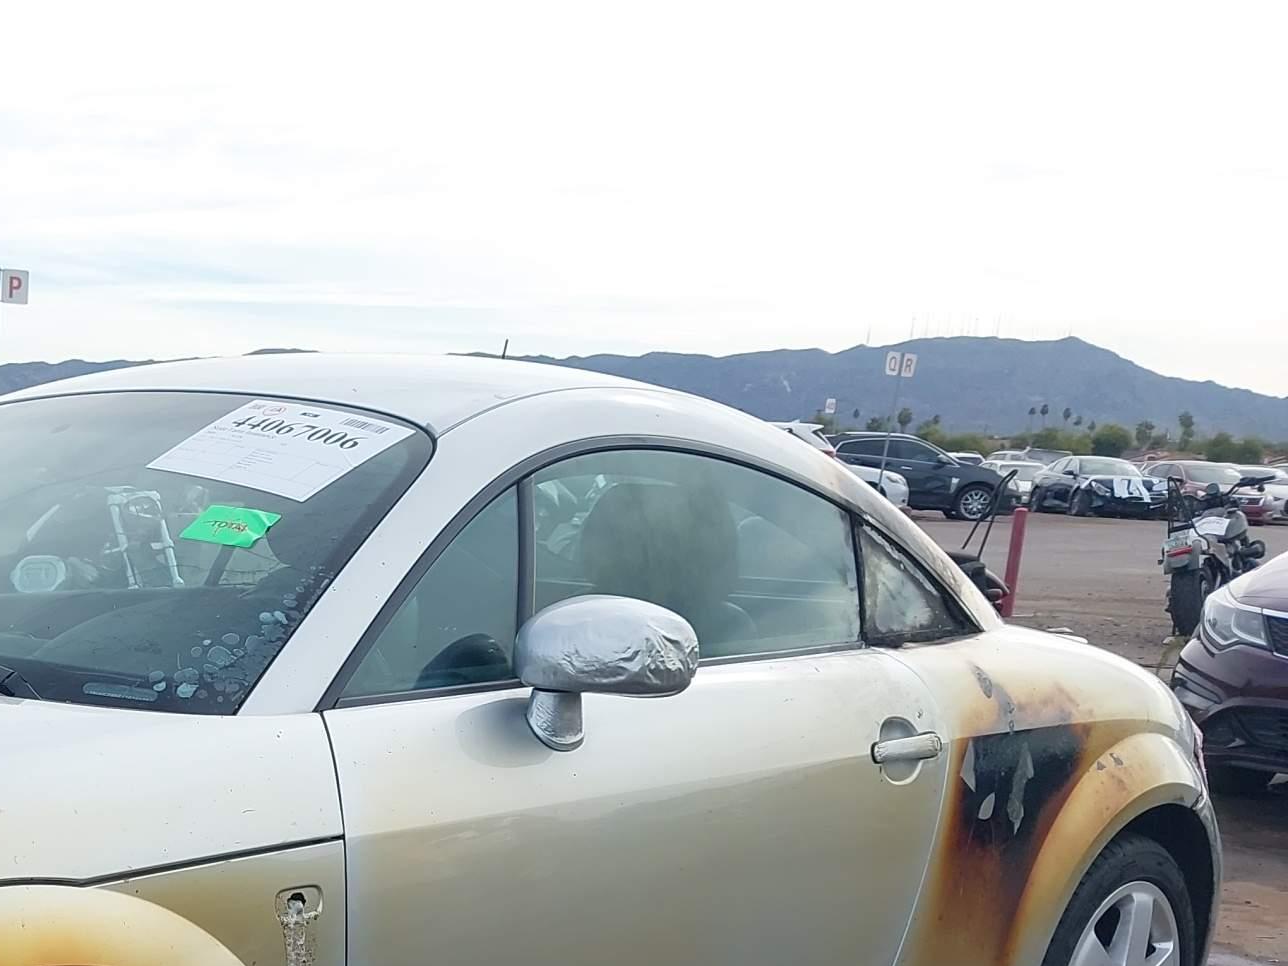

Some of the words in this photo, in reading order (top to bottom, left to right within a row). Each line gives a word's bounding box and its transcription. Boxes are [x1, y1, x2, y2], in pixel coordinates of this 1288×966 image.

[8, 276, 23, 299] P
[888, 356, 897, 372] Q
[904, 358, 913, 374] R
[231, 414, 368, 451] 44067006
